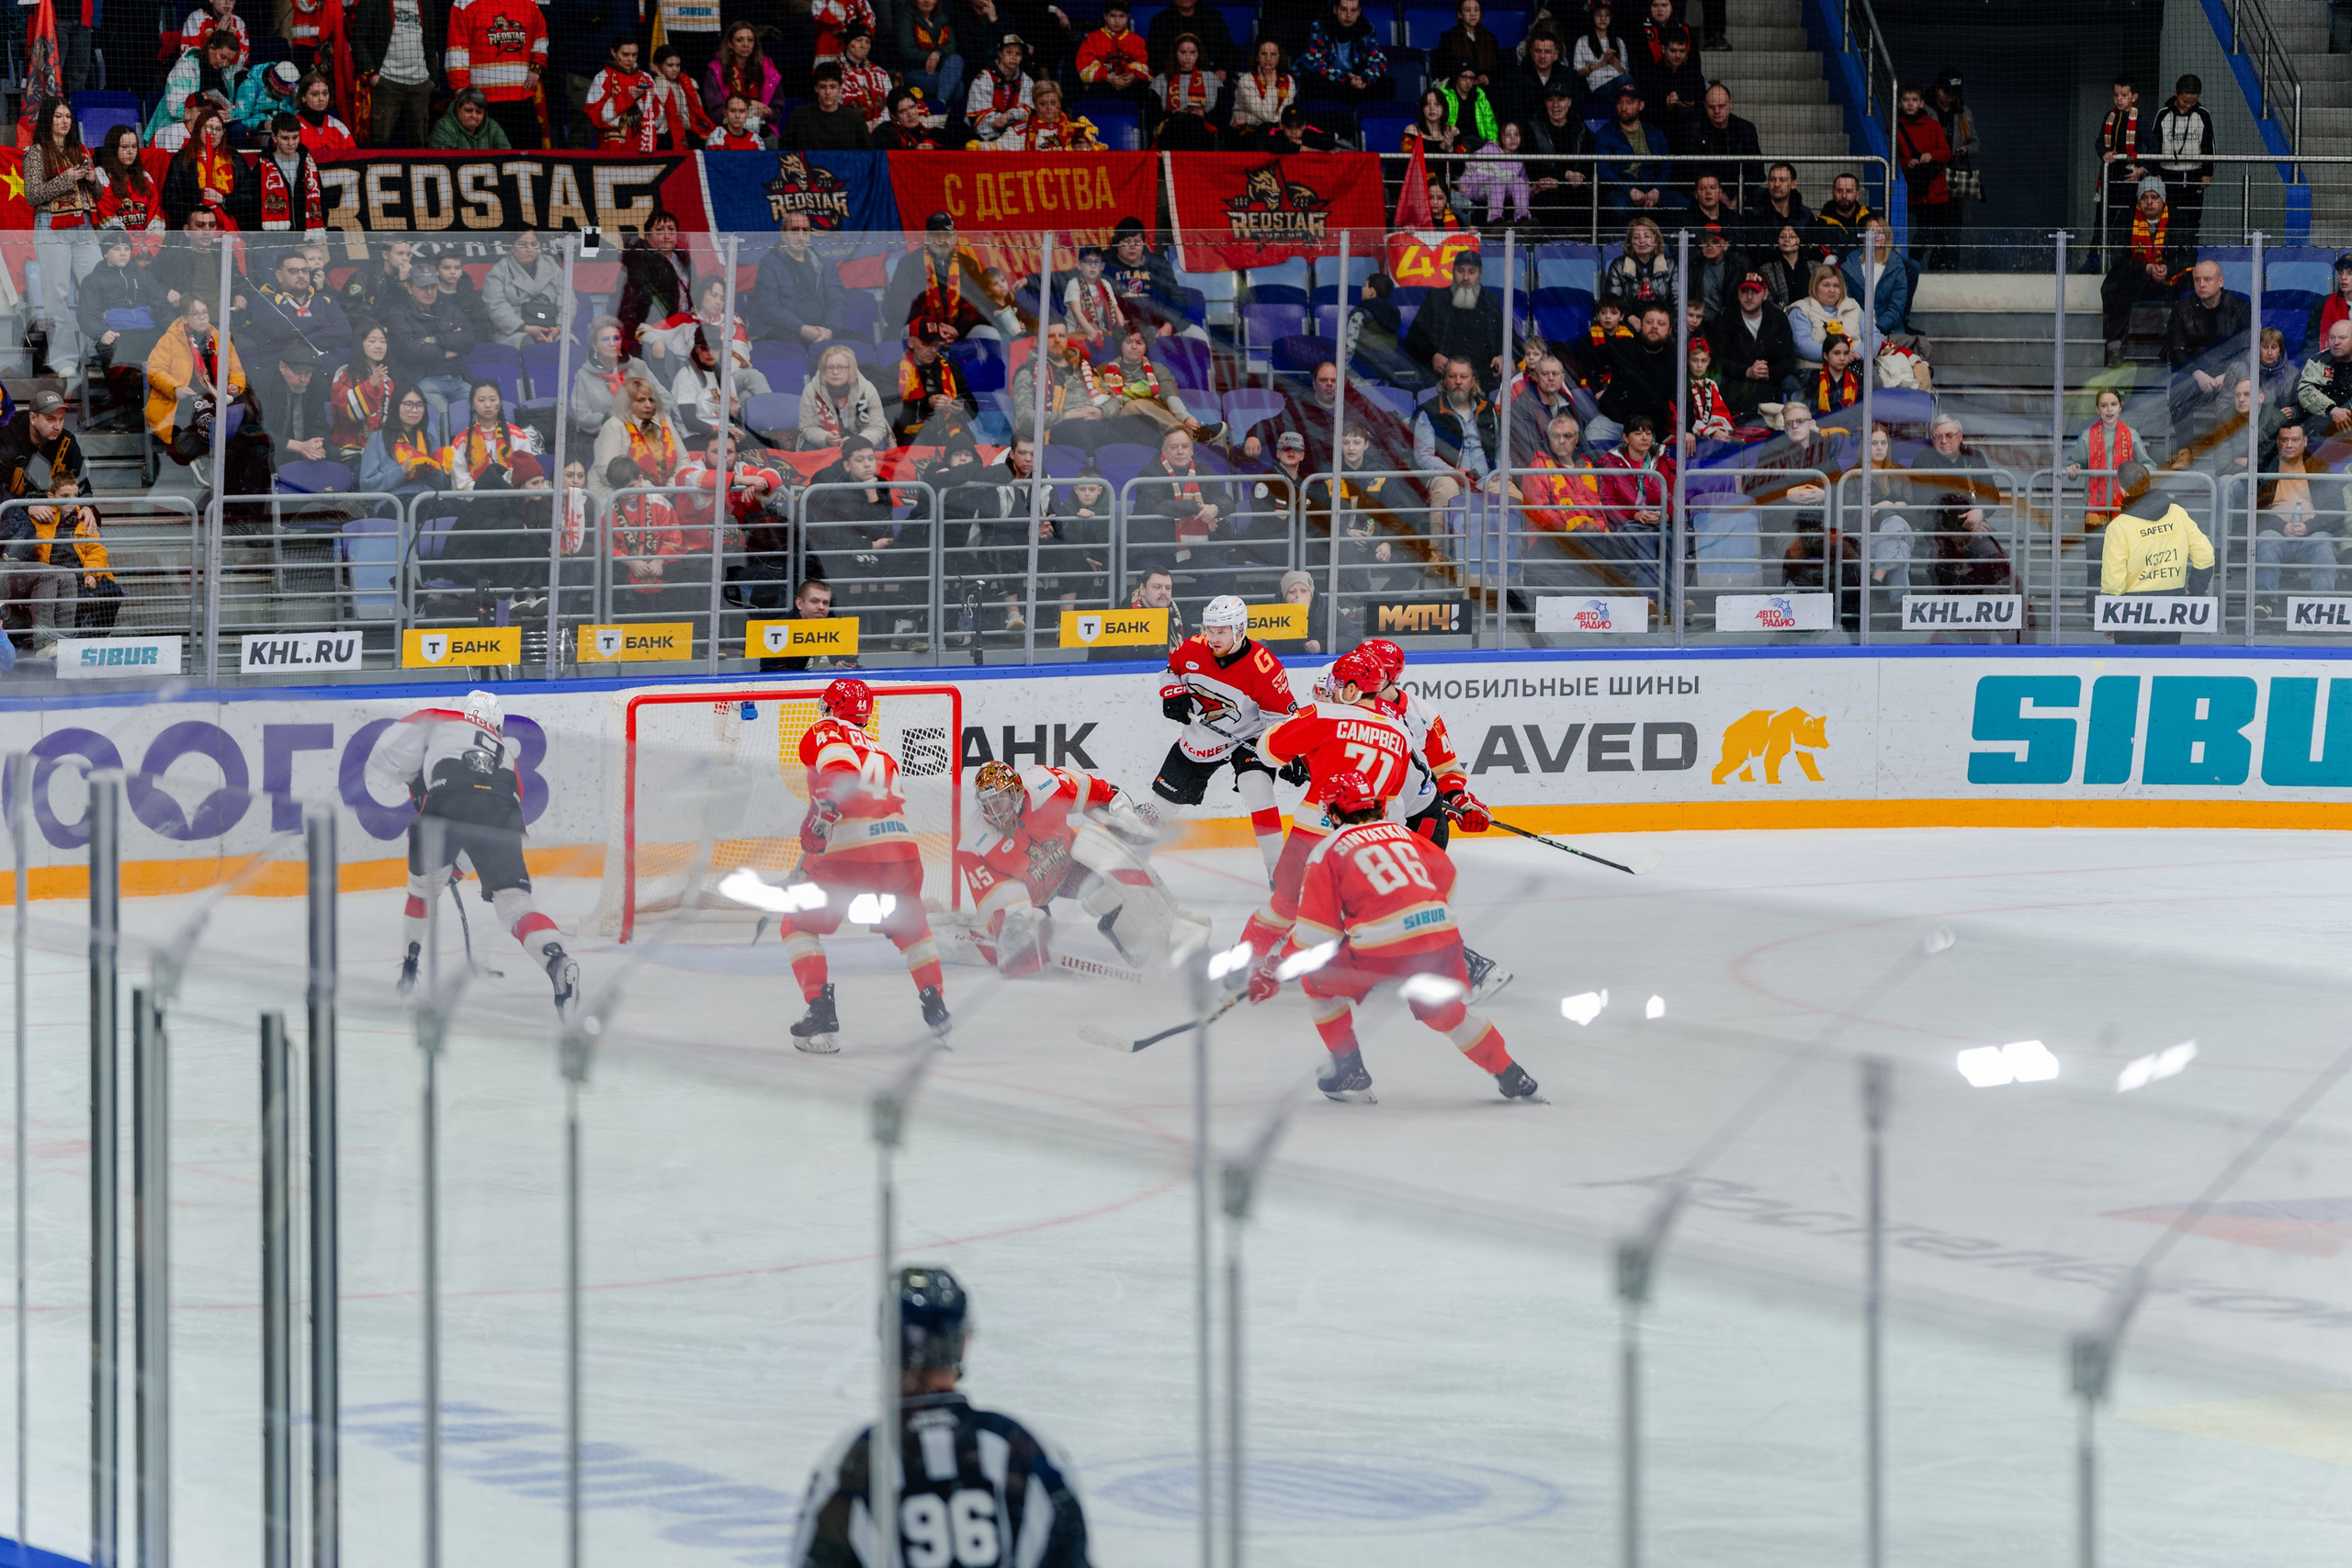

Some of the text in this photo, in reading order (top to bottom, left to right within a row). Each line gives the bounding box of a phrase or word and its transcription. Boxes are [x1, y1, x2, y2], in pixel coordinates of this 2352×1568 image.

[944, 165, 1116, 221] С ДЕТСТВА
[765, 191, 851, 223] REDSTAR
[1226, 210, 1329, 240] REDSTAR
[2140, 523, 2174, 537] SAFETY
[2145, 548, 2177, 567] K3721
[2138, 566, 2182, 581] SAFETY
[1247, 615, 1291, 629] БАНК
[1573, 611, 1600, 621] АВТО
[1755, 609, 1782, 620] АВТО
[1762, 617, 1795, 627] РАДИО
[1909, 601, 2015, 624] KHL.RU
[2102, 602, 2211, 625] KHL.RU
[1105, 621, 1150, 634] БАНК
[1579, 618, 1611, 630] РАДИО
[451, 639, 502, 653] БАНК
[625, 636, 674, 649] БАНК
[793, 631, 840, 644] БАНК
[80, 646, 159, 667] SIBUR
[248, 638, 356, 666] KHL.RU
[1610, 675, 1700, 696] ШИНЫ
[856, 700, 867, 711] 44
[902, 721, 1100, 777] БАНК
[1336, 721, 1405, 758] CAMPBELL
[1459, 722, 1698, 775] AVED
[1344, 741, 1396, 799] 71
[967, 864, 995, 890] 45
[1353, 840, 1437, 897] 86
[1403, 908, 1446, 931] SIBUR
[900, 1487, 1000, 1568] 96
